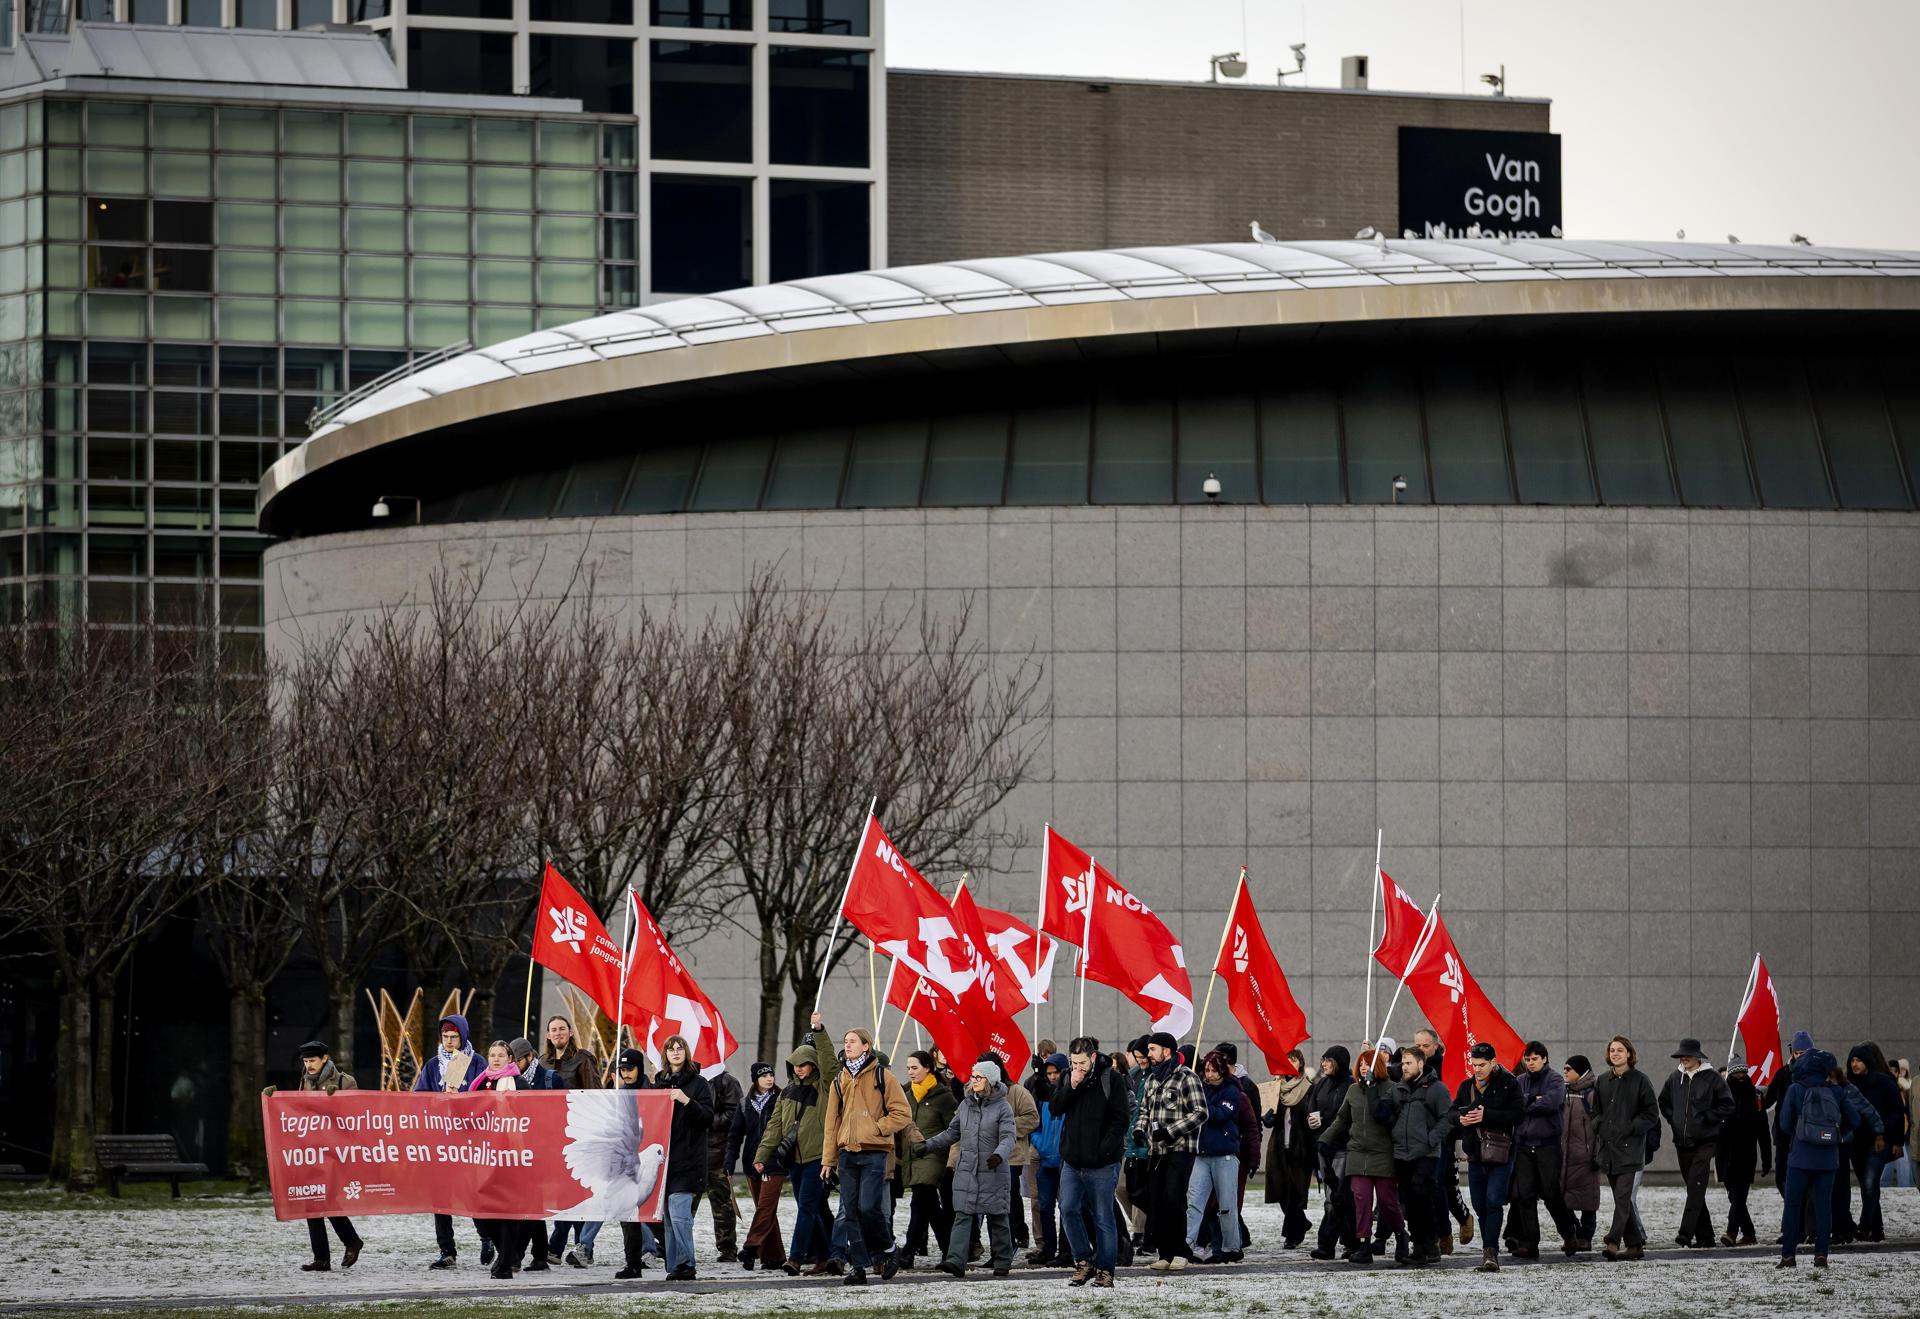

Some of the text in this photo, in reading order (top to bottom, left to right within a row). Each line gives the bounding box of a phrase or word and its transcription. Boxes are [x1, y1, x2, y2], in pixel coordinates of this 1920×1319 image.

[1486, 152, 1540, 182] Van
[1464, 187, 1540, 222] Gogh
[590, 943, 627, 971] jongere
[280, 1109, 531, 1138] tegen oorlog en imperialisme
[282, 1138, 534, 1167] voor vrede en socialisme
[295, 1184, 326, 1197] NCPN
